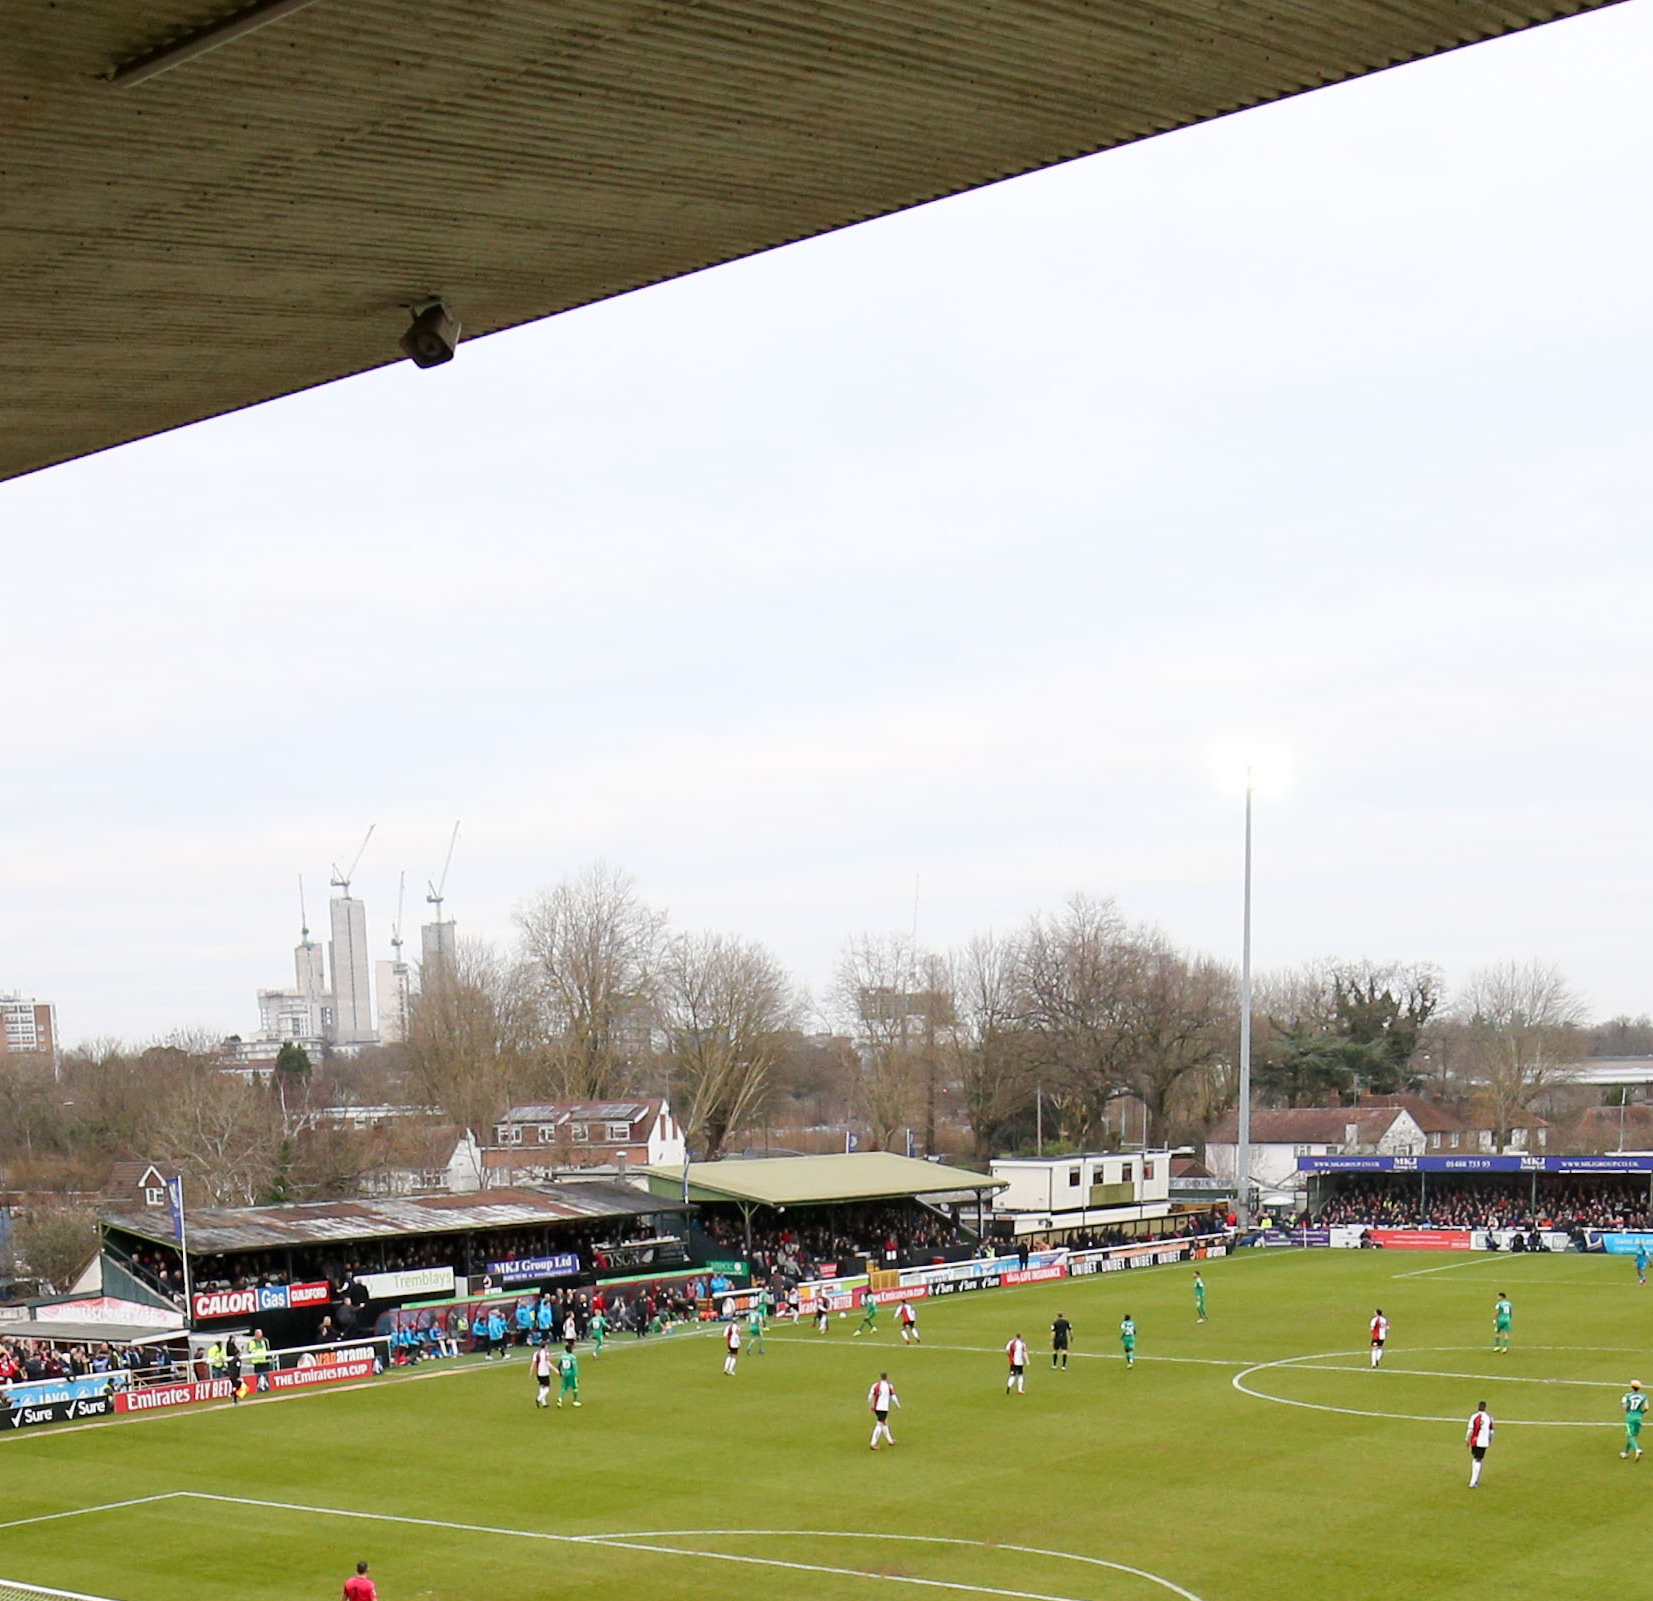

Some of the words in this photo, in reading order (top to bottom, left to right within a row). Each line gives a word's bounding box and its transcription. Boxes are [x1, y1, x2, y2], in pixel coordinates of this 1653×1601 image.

[1394, 1158, 1417, 1166] MKJ
[1521, 1157, 1545, 1165] MKJ
[494, 1260, 520, 1274] MKJ
[522, 1258, 553, 1272] Group
[555, 1255, 572, 1268] Ltd
[1072, 1262, 1097, 1276] UNIBET
[1102, 1258, 1125, 1272] UNIBET
[1130, 1254, 1154, 1268] UNIBET
[1158, 1250, 1180, 1264] UNIBET
[395, 1271, 452, 1289] Tremblays
[940, 1284, 954, 1294] Sure
[964, 1279, 977, 1290] Sure
[987, 1276, 999, 1287] Sure
[196, 1292, 255, 1316] CALOR
[261, 1291, 285, 1308] Gas
[291, 1286, 327, 1302] GUILDFORD
[315, 1347, 375, 1366] vanarama
[273, 1374, 294, 1387] THE
[294, 1368, 336, 1385] Emirates
[337, 1367, 347, 1379] FA
[346, 1364, 367, 1377] CUP
[127, 1388, 190, 1411] Emirates
[195, 1384, 210, 1400] FLY
[212, 1382, 233, 1398] BET
[1630, 1399, 1642, 1410] 17
[24, 1408, 52, 1423] Sure
[77, 1400, 105, 1416] Sure
